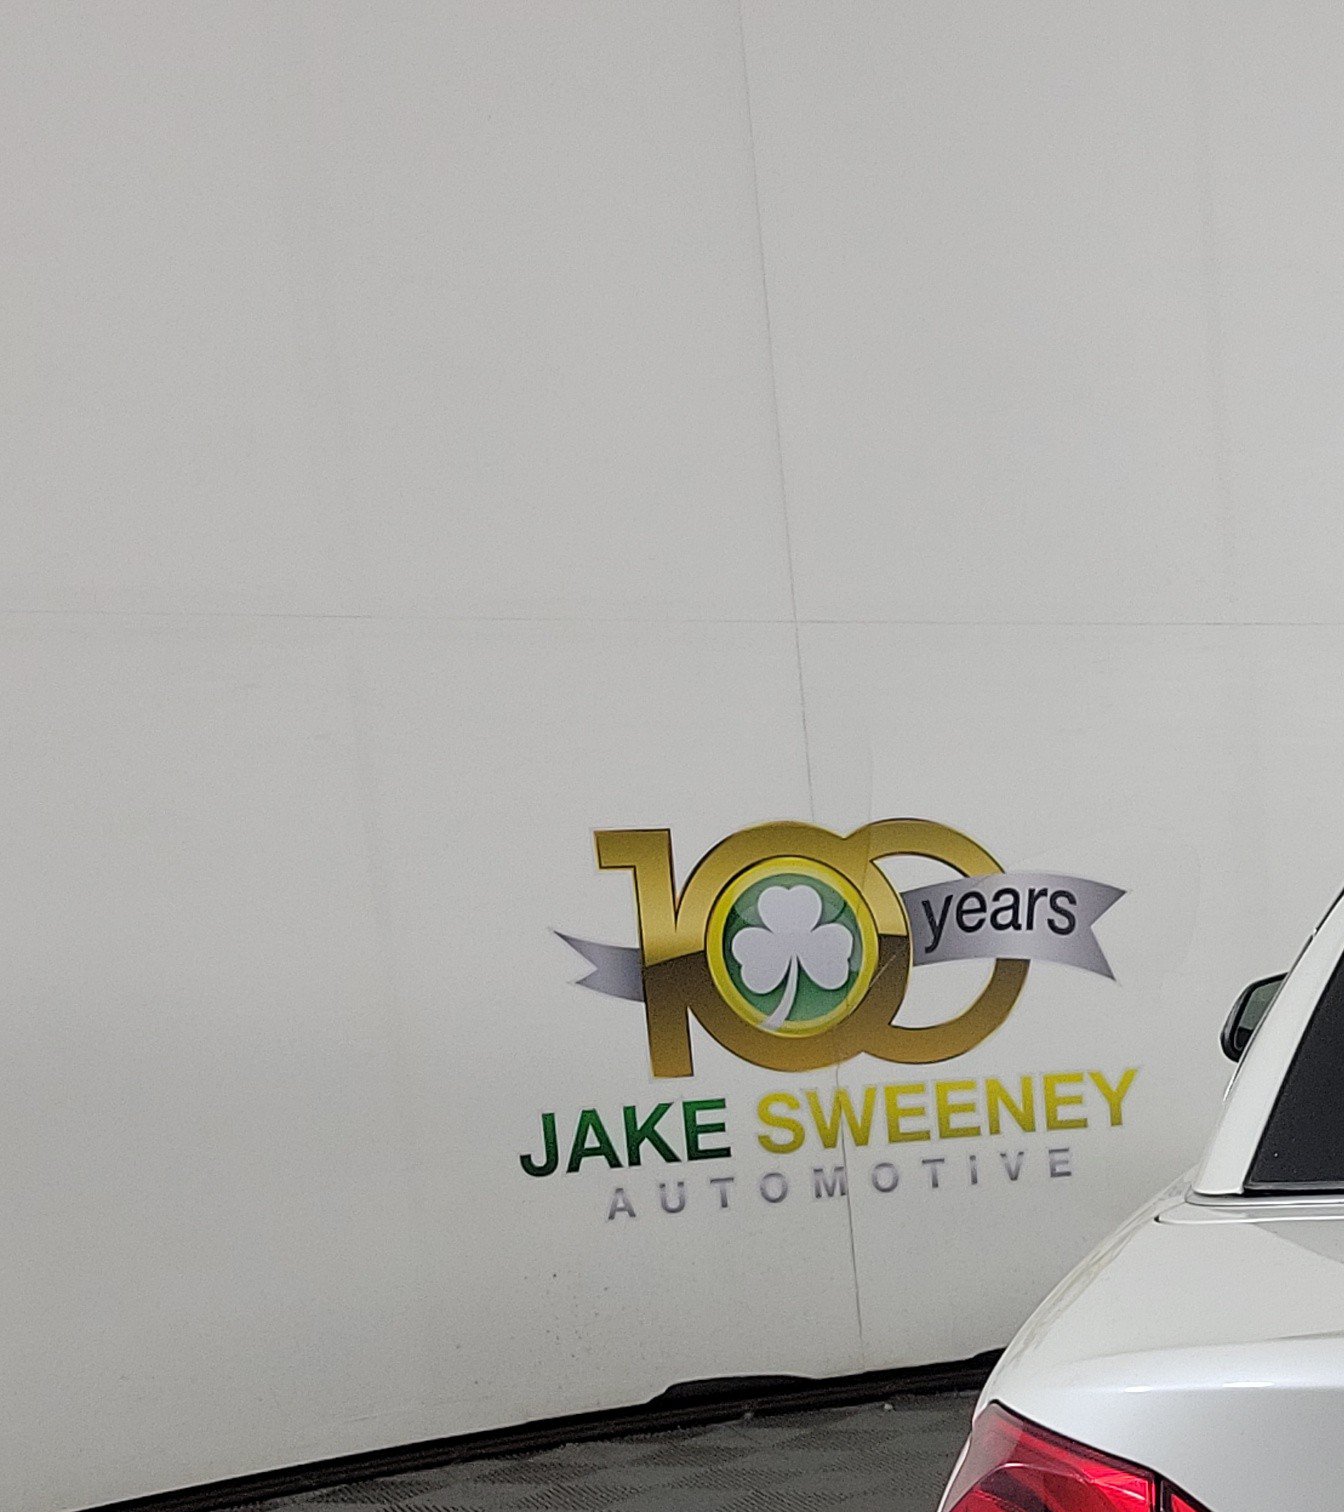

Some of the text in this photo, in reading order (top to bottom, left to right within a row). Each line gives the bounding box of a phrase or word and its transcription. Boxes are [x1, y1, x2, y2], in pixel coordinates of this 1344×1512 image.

[921, 887, 1078, 954] years
[519, 1068, 1138, 1178] JAKE SWEENEY
[606, 1147, 1074, 1222] AUTOMOTIVE
